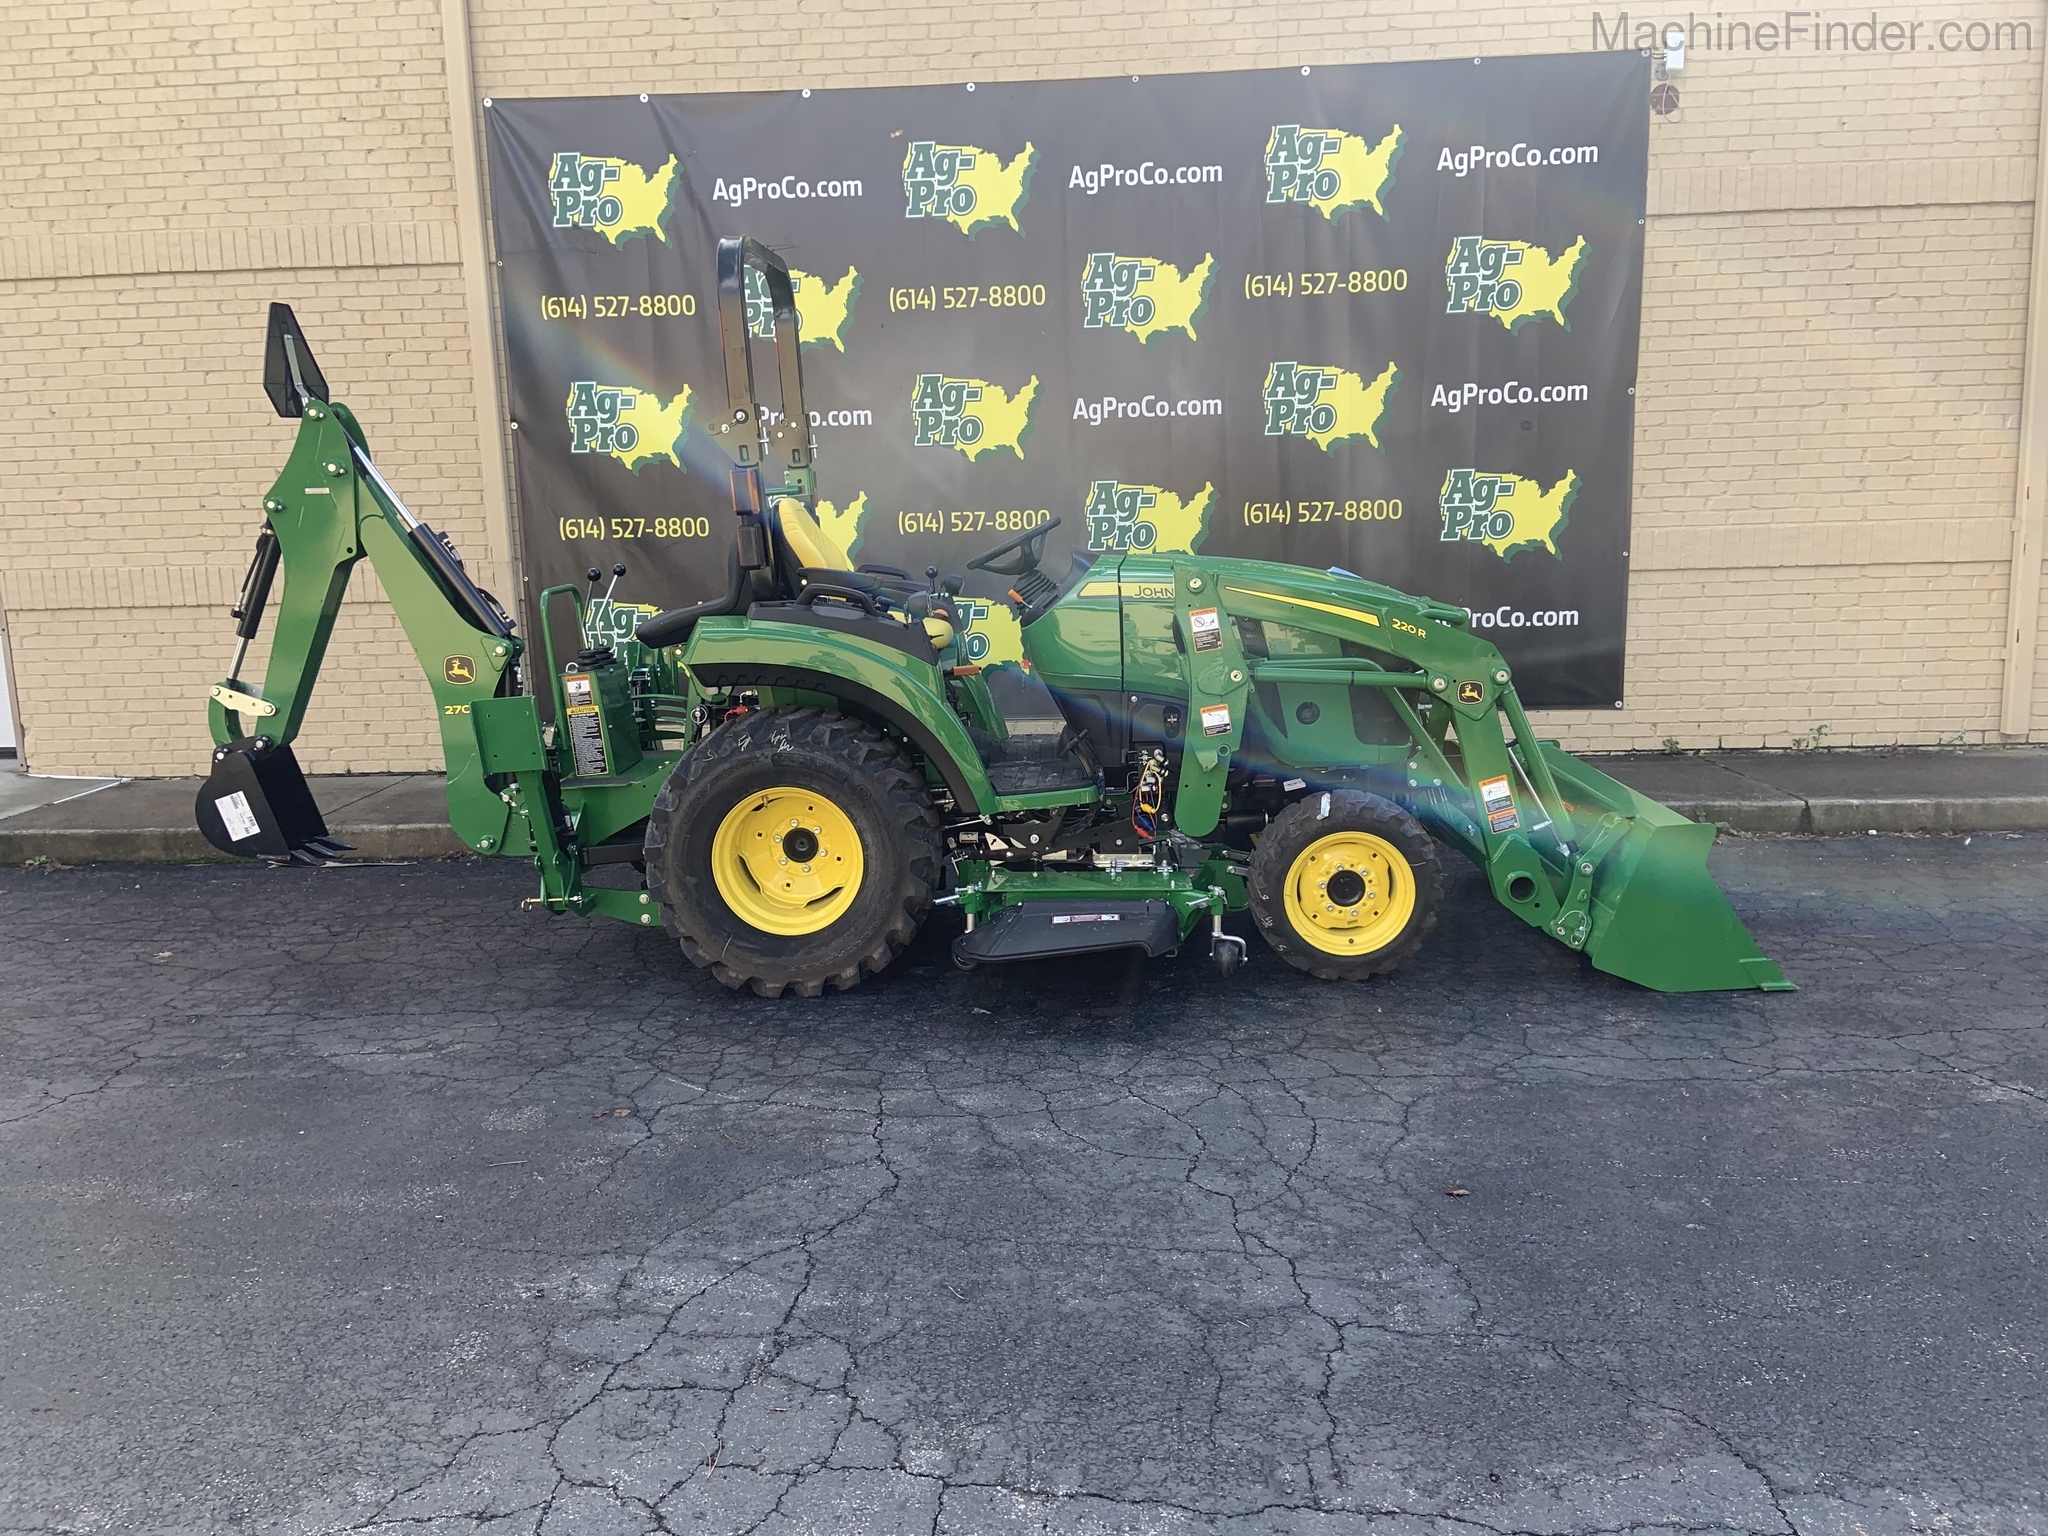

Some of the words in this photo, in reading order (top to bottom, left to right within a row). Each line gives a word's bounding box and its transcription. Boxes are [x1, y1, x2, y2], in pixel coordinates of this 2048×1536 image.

[904, 141, 975, 188] Ag-
[1266, 124, 1340, 170] Ag-
[1436, 143, 1599, 177] AgProCo.com
[551, 152, 620, 198] Ag-
[712, 175, 863, 208] AgProCo.com
[1068, 161, 1223, 195] AgProCo.com
[1266, 163, 1340, 203] Pro
[552, 190, 622, 227] Pro
[905, 180, 976, 218] Pro
[1083, 253, 1154, 299] Ag-
[1447, 236, 1523, 283] Ag-
[889, 288, 937, 311] (614)
[943, 284, 1047, 309] 527-8800
[1244, 273, 1294, 298] (614)
[1301, 269, 1408, 295] 527-8800
[1446, 274, 1522, 313] Pro
[541, 296, 587, 319] (614)
[593, 294, 696, 317] 527-8800
[1084, 290, 1154, 328] Pro
[913, 374, 981, 418] Ag-
[1265, 362, 1337, 406] Ag-
[1431, 381, 1588, 413] AgProCo.com
[569, 382, 635, 424] Ag-
[1072, 395, 1222, 426] AgProCo.com
[1265, 398, 1336, 435] Pro
[571, 417, 638, 453] Pro
[914, 409, 983, 446] Pro
[1087, 480, 1155, 523] Ag-
[1441, 469, 1515, 512] Ag-
[559, 518, 605, 539] (614)
[611, 516, 710, 538] 527-8800
[897, 511, 945, 534] (614)
[1243, 502, 1291, 525] (614)
[1298, 499, 1403, 522] 527-8800
[1440, 505, 1514, 541] Pro
[1088, 516, 1156, 551] Pro
[1133, 585, 1174, 598] JOHN
